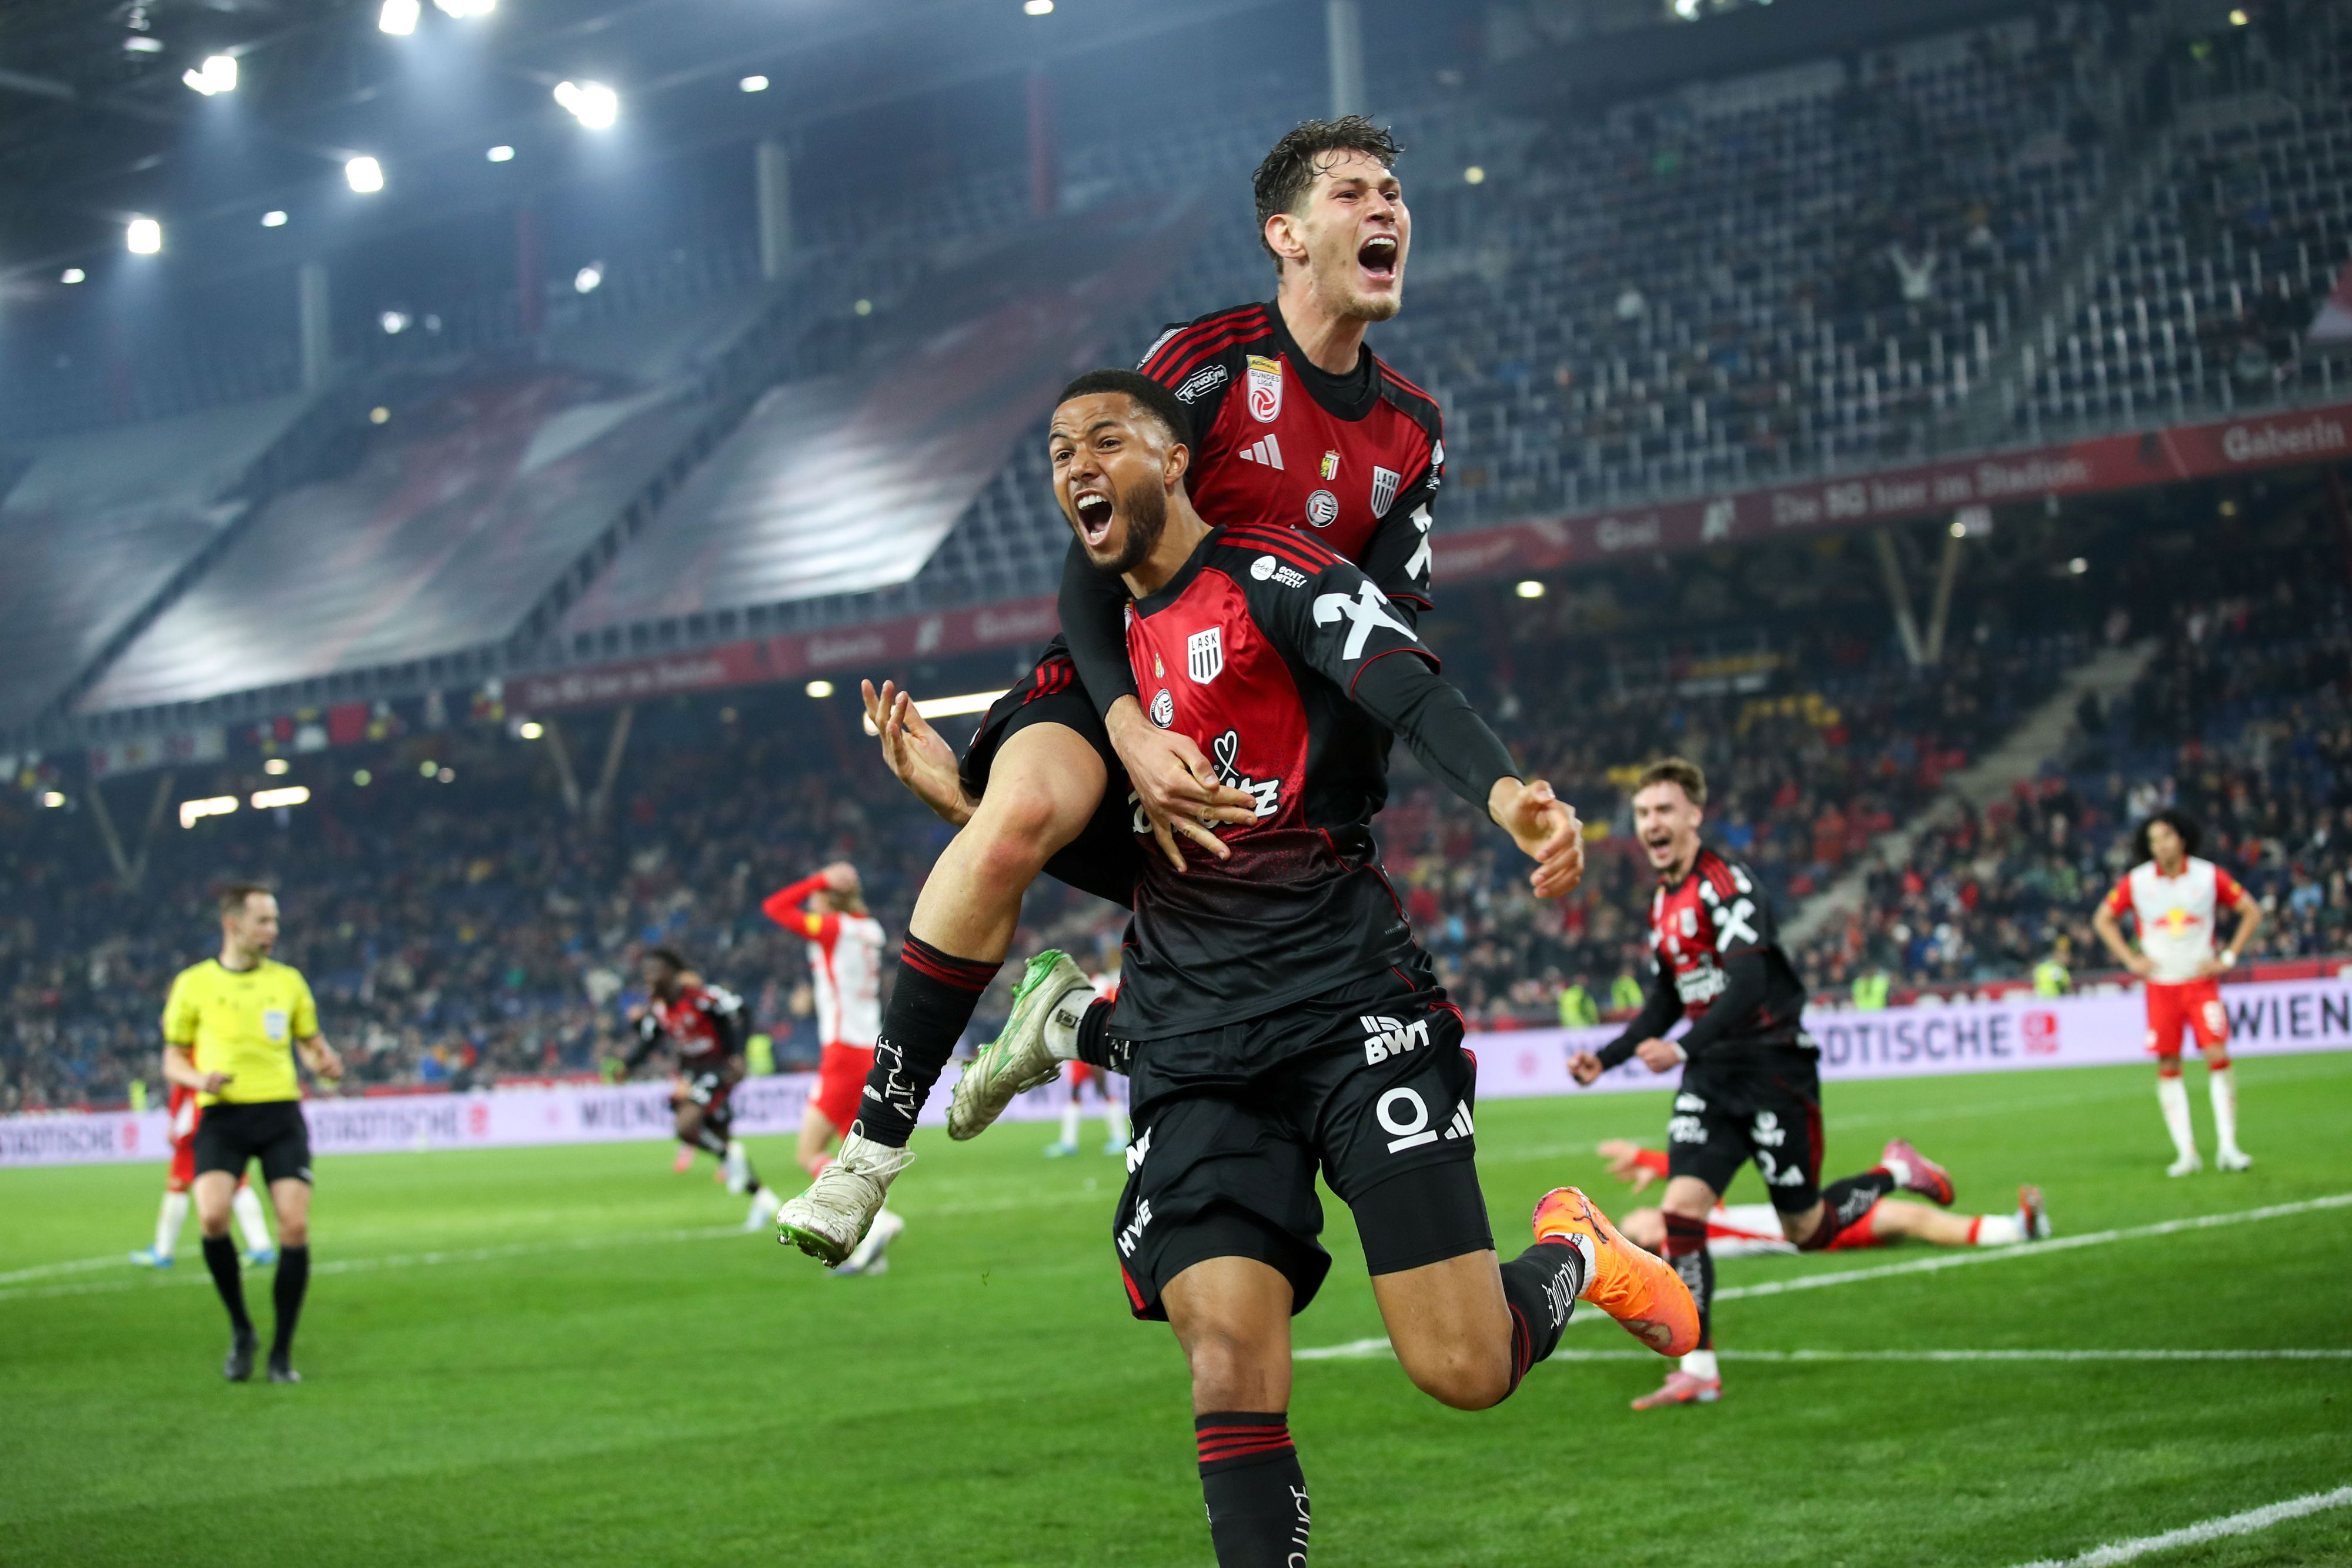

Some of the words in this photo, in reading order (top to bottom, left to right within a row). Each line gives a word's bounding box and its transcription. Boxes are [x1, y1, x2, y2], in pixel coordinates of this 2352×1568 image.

[1251, 370, 1280, 382] BUNDES
[1257, 378, 1272, 387] LIGA
[1377, 471, 1398, 488] LASK
[1191, 632, 1217, 651] LASK
[1364, 1019, 1430, 1066] BWT
[1825, 1013, 2012, 1067] DTISCHE
